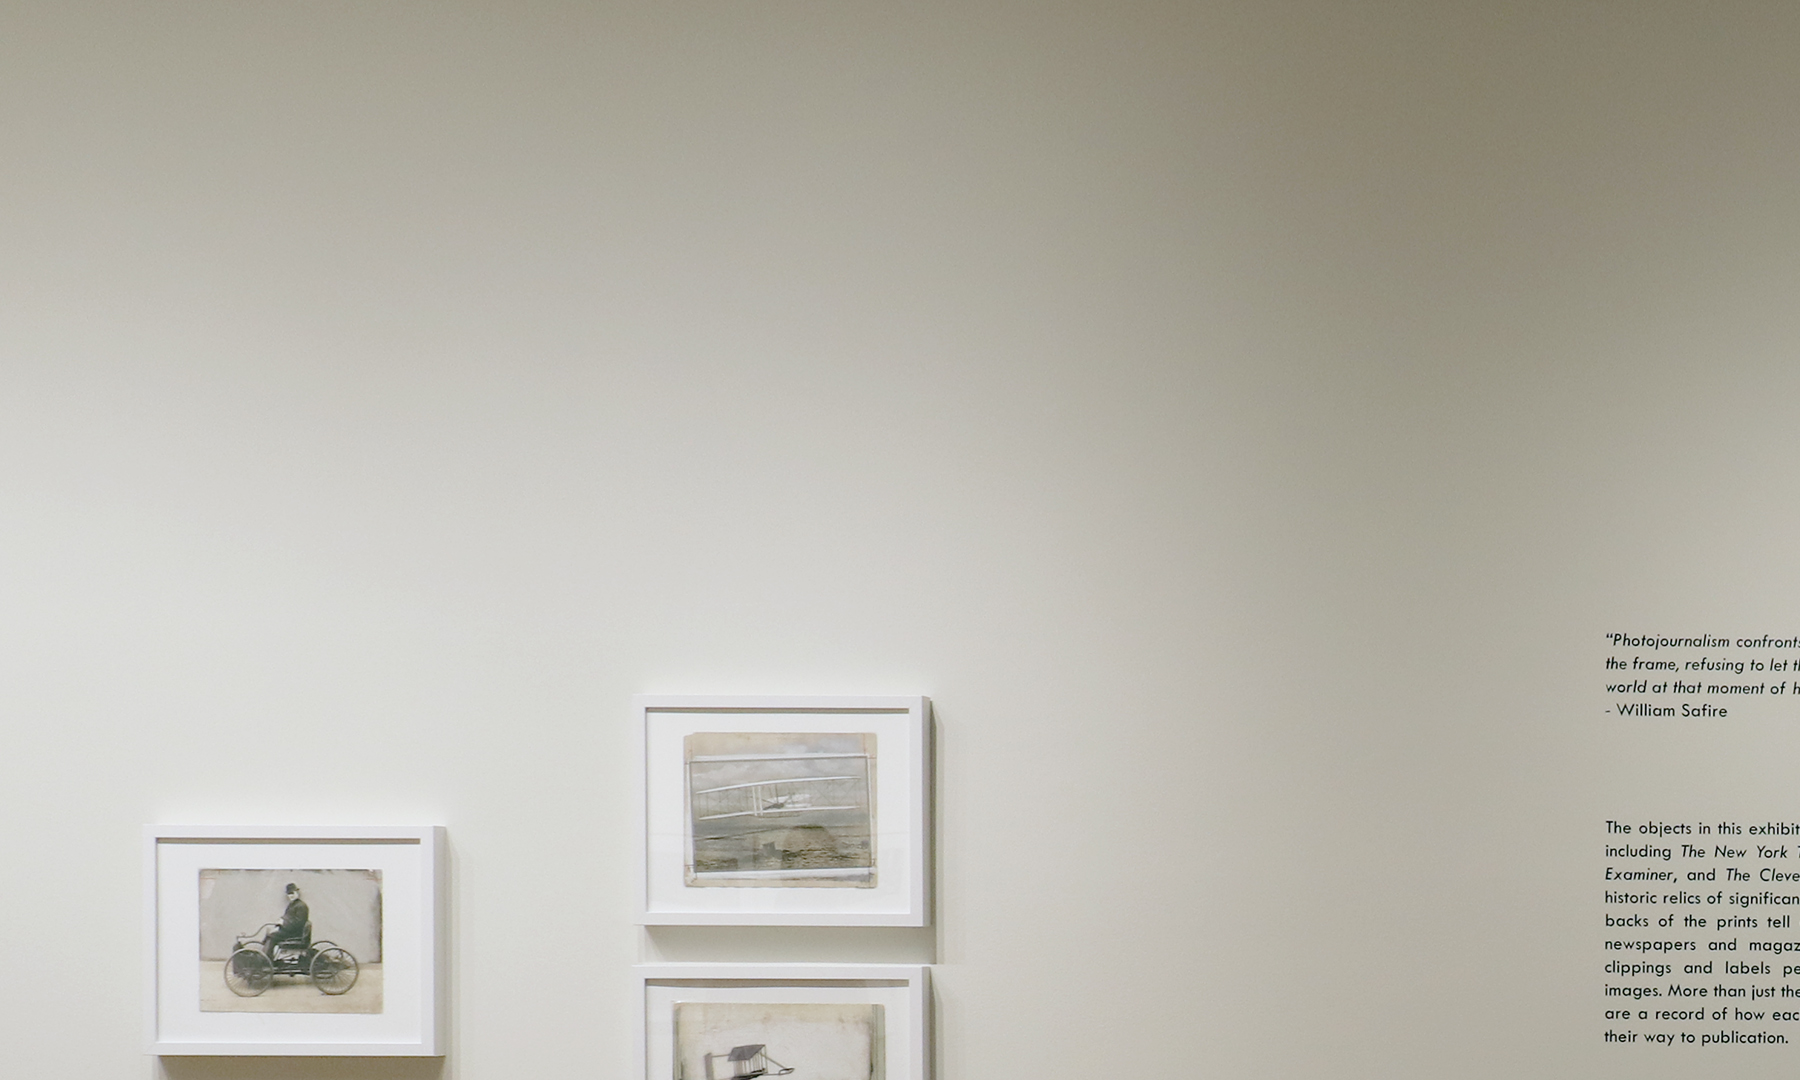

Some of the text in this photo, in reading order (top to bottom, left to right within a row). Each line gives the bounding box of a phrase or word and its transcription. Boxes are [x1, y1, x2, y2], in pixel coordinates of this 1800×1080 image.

[1605, 655, 1628, 671] the
[1632, 655, 1680, 674] frame,
[1684, 656, 1745, 675] refusing
[1749, 658, 1765, 672] to
[1769, 657, 1789, 672] let
[1605, 679, 1648, 694] world
[1651, 681, 1669, 694] at
[1672, 679, 1703, 695] that
[1706, 681, 1766, 695] moment
[1769, 680, 1787, 696] of
[1615, 702, 1676, 717] William
[1680, 703, 1728, 718] Safire
[1605, 819, 1632, 835] The
[1638, 820, 1693, 839] objects
[1698, 821, 1711, 835] in
[1717, 820, 1743, 836] this
[1605, 843, 1672, 862] including
[1680, 843, 1706, 859] The
[1713, 844, 1748, 859] New
[1756, 844, 1789, 859] York
[1604, 866, 1678, 884] Examiner,
[1686, 867, 1716, 882] and
[1725, 867, 1751, 882] The
[1604, 889, 1658, 905] historic
[1662, 890, 1702, 905] relics
[1706, 890, 1723, 905] of
[1605, 913, 1649, 928] backs
[1657, 913, 1675, 928] of
[1683, 913, 1708, 928] the
[1716, 914, 1759, 932] prints
[1766, 914, 1791, 929] tell
[1604, 940, 1697, 955] newspapers
[1707, 937, 1737, 952] and
[1604, 959, 1672, 978] clippings
[1683, 960, 1713, 975] and
[1725, 960, 1771, 975] labels
[1604, 983, 1663, 1001] images.
[1667, 983, 1709, 998] More
[1712, 983, 1747, 998] than
[1751, 984, 1777, 1002] just
[1604, 1009, 1631, 1020] are
[1637, 1010, 1648, 1021] a
[1655, 1006, 1705, 1021] record
[1711, 1006, 1729, 1021] of
[1734, 1006, 1766, 1022] how
[1603, 1028, 1789, 1048] their way to publication.
